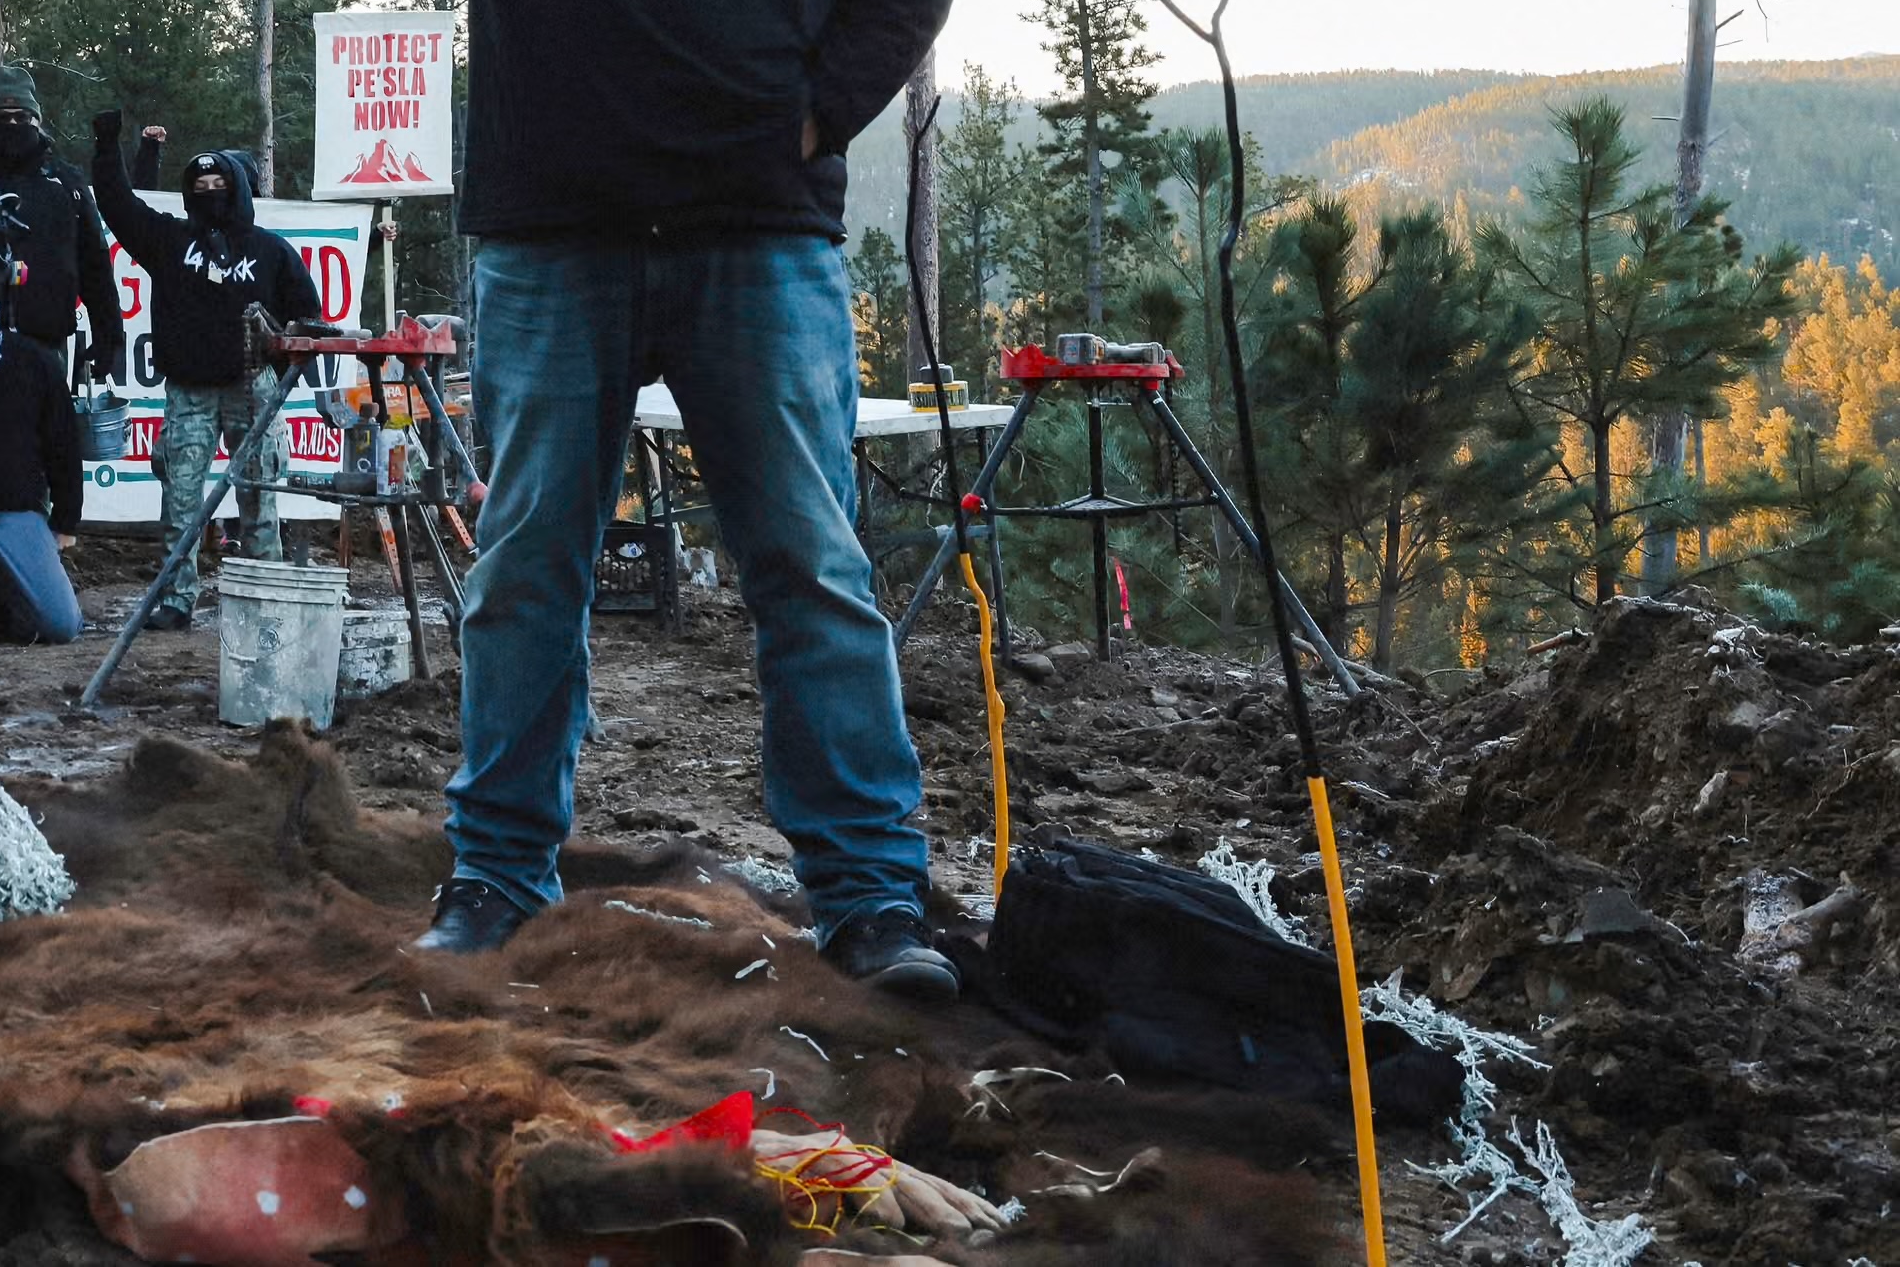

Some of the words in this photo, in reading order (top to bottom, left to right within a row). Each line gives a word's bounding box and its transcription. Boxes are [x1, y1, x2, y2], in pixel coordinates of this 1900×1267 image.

[332, 33, 442, 66] PROTECT
[347, 66, 427, 98] PE'SLA
[354, 100, 420, 131] NOW!
